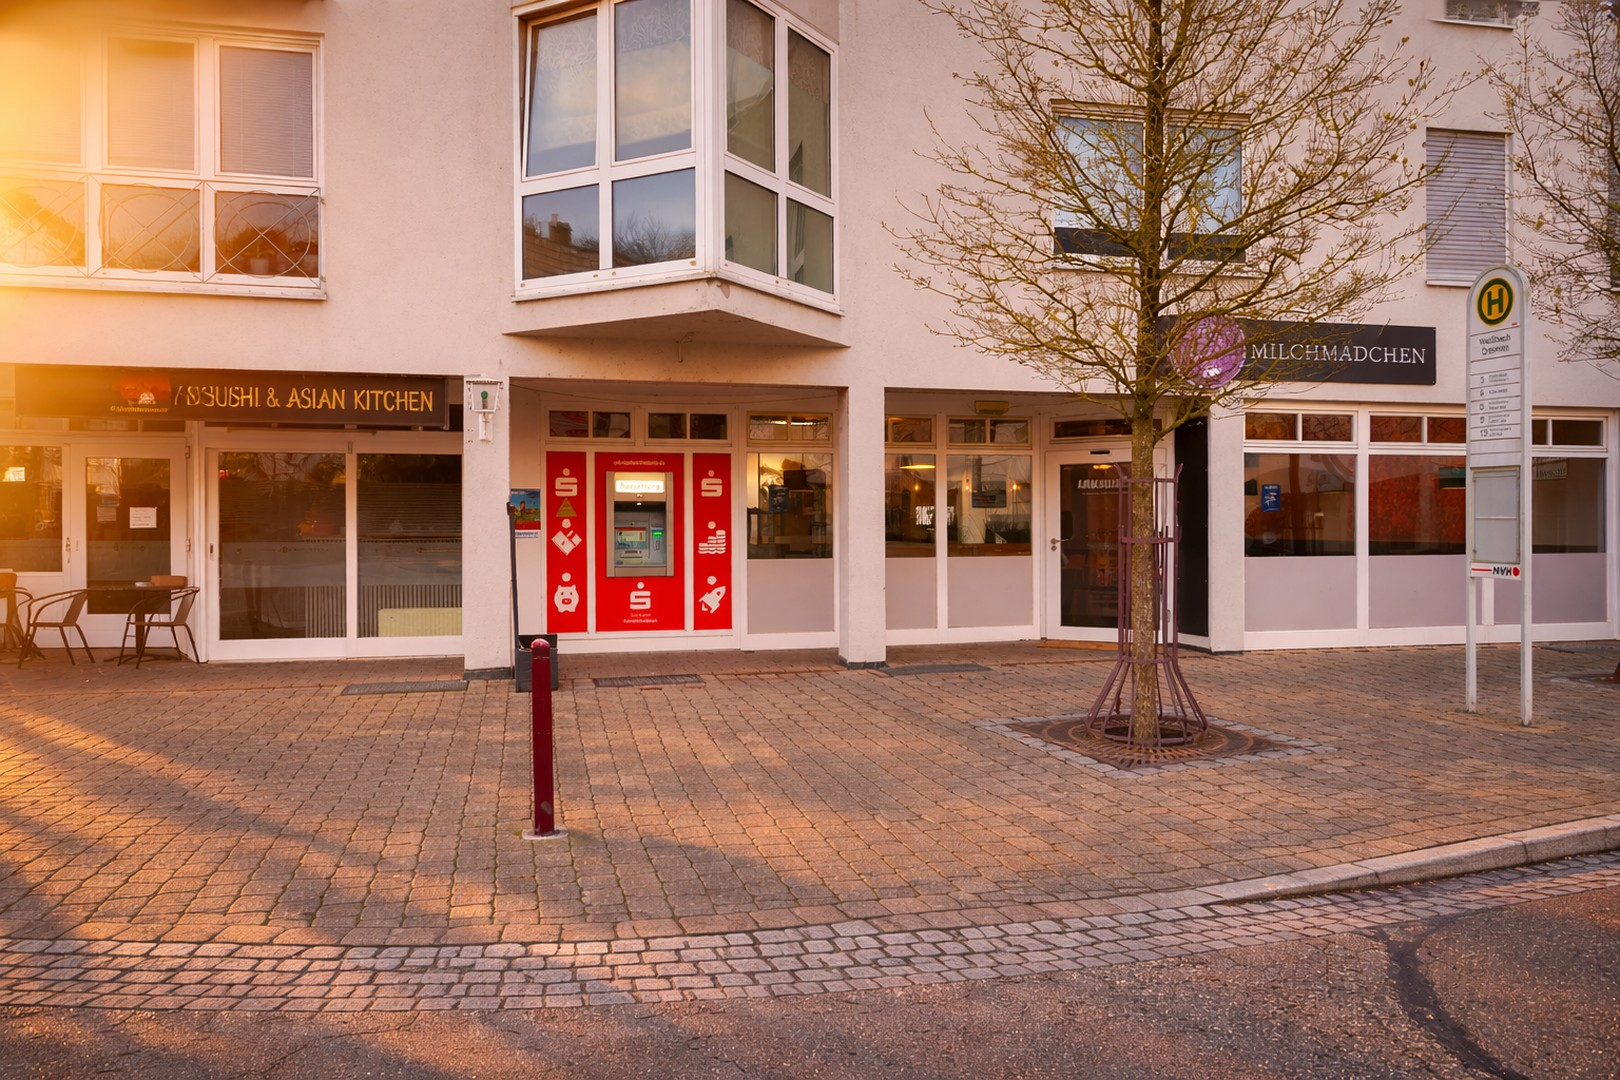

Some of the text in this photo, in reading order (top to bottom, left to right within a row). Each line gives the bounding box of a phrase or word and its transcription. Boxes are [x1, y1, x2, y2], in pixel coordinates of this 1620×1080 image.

[1487, 288, 1504, 316] H
[266, 387, 281, 408] &
[286, 387, 346, 410] ASIAN
[353, 389, 434, 412] KITCHEN
